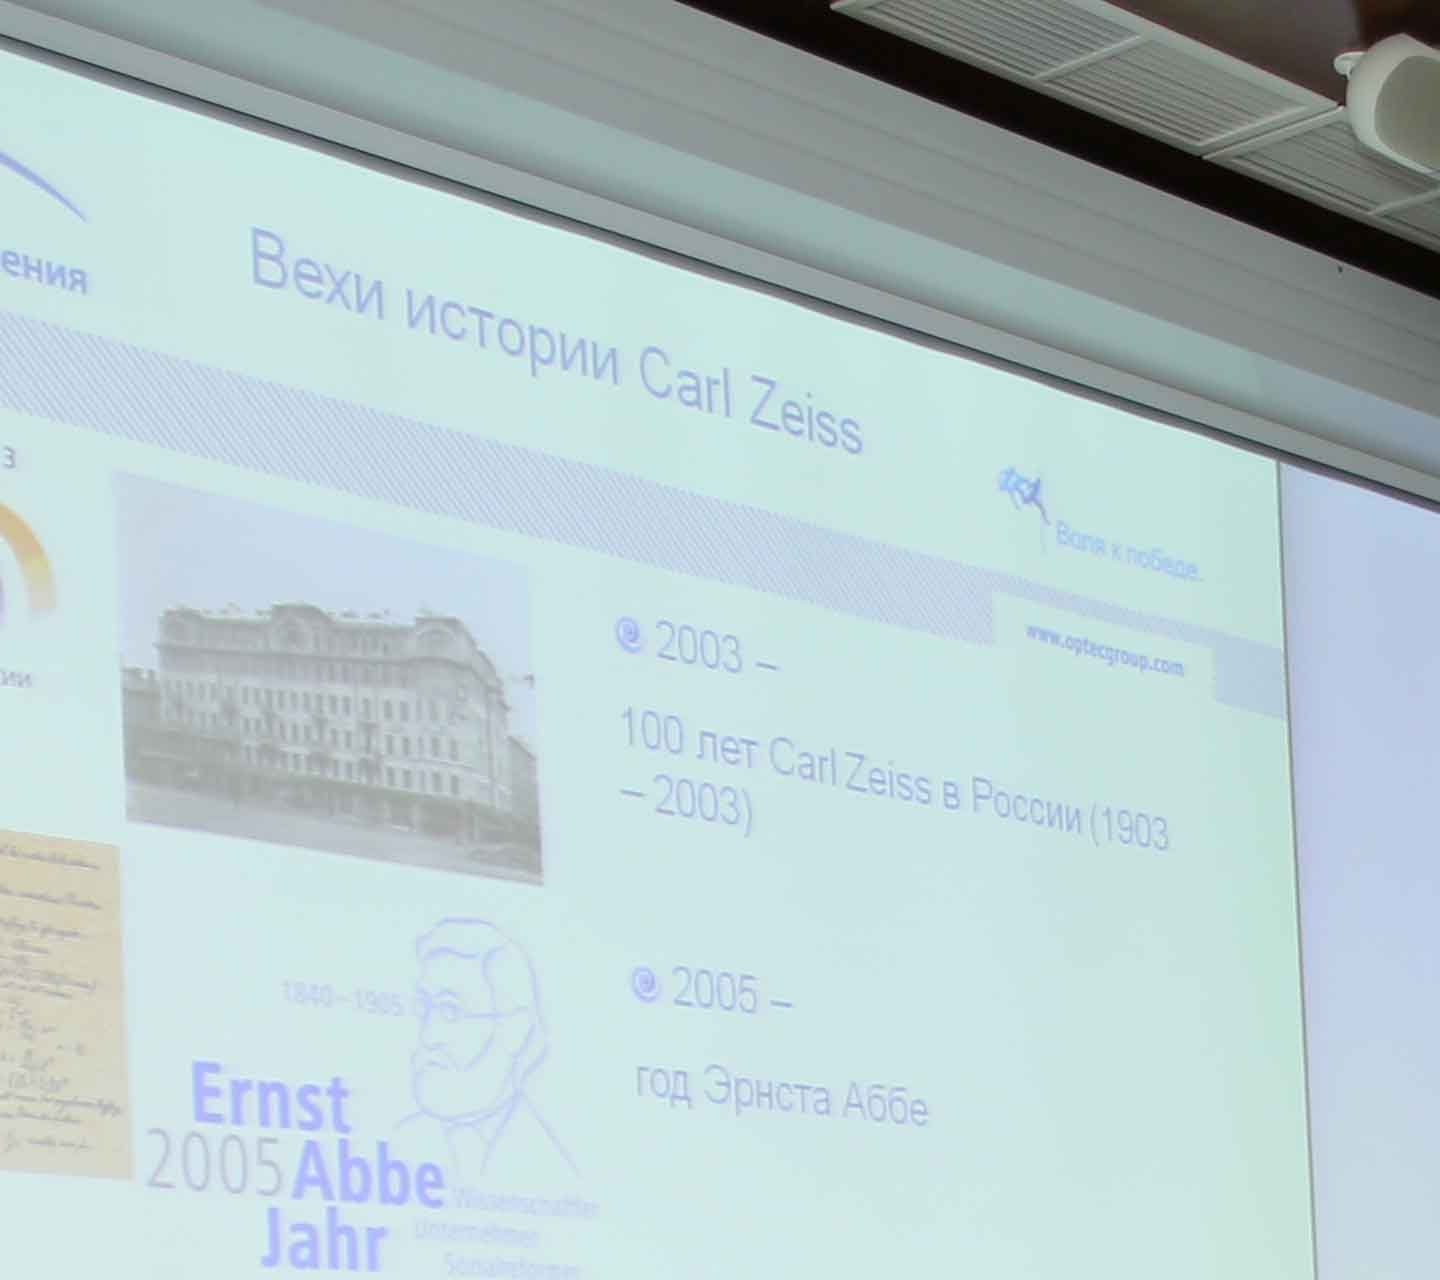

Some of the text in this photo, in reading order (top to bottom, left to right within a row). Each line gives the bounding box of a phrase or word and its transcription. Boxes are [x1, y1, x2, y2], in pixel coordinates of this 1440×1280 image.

[251, 226, 864, 455] Вехи истории Carl Zeiss
[656, 620, 744, 674] 2003
[1025, 624, 1186, 678] www.optecgroup.com
[621, 706, 1170, 852] 100 лет Carl Zeiss в России (1903
[654, 773, 754, 839] 2003)
[672, 965, 762, 1014] 2005
[191, 1059, 354, 1135] Ernst
[635, 1063, 930, 1127] год Эрнста Аббе
[144, 1127, 285, 1199] 2005
[291, 1137, 447, 1210] Abbe
[260, 1205, 390, 1273] Jahr
